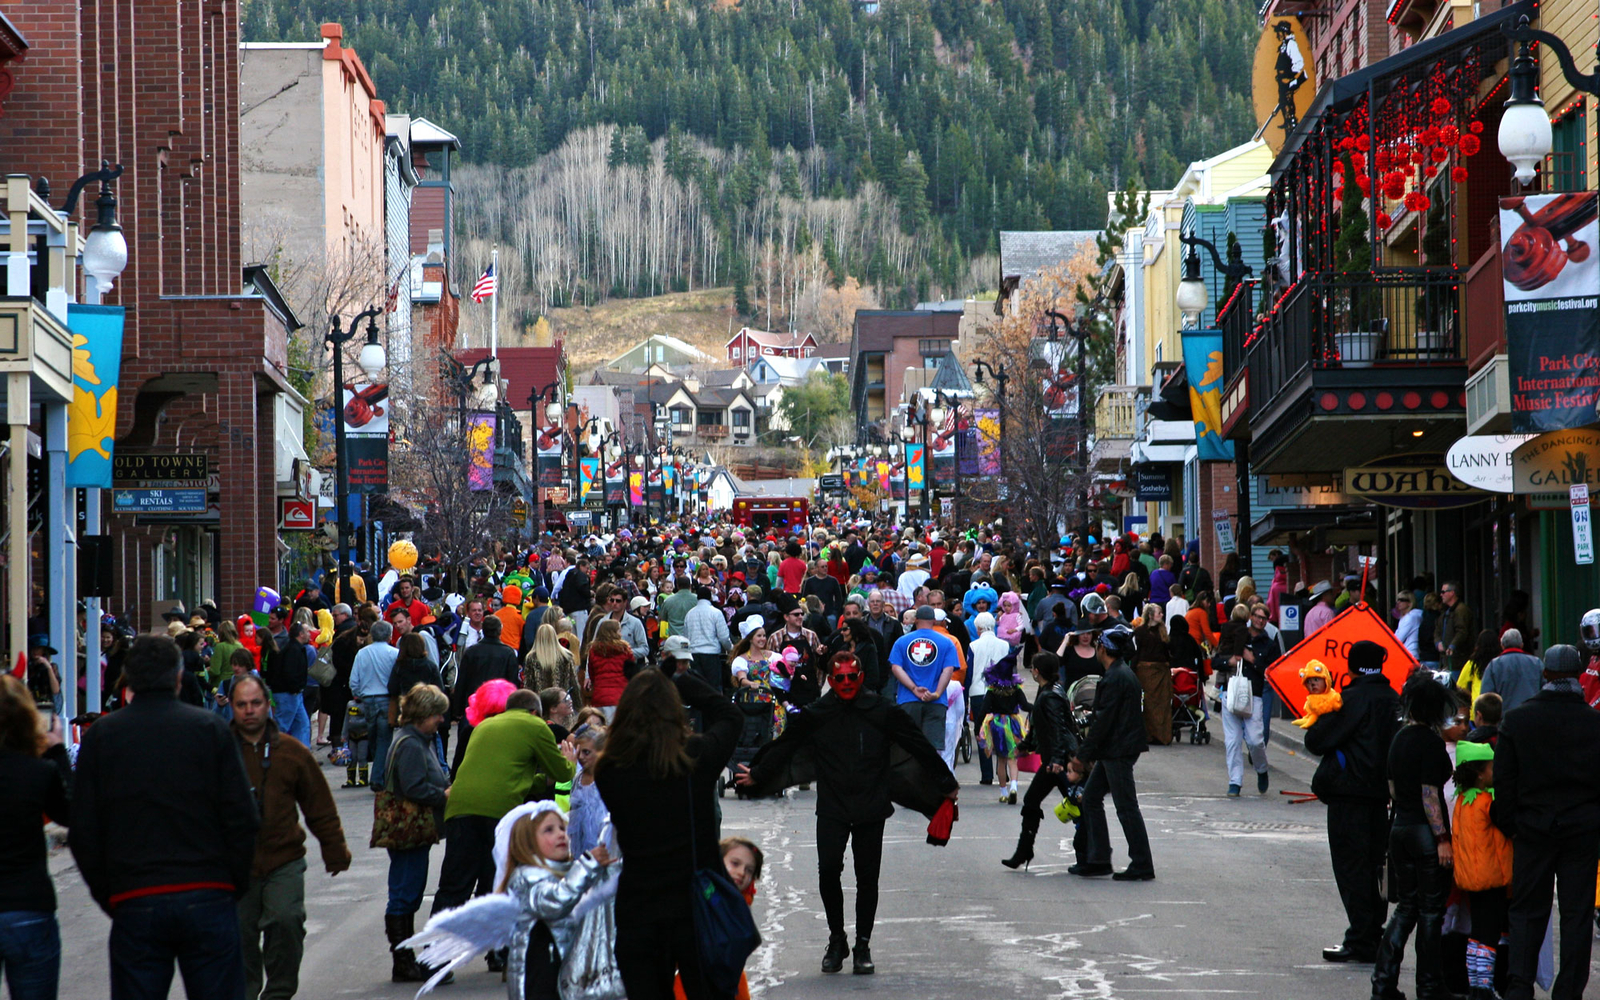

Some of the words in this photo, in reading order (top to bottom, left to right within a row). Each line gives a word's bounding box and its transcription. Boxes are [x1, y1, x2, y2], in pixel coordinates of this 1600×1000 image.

[1508, 298, 1598, 314] parkcitymusicfestival.org
[1539, 354, 1571, 371] Park
[1513, 392, 1552, 411] Music
[1541, 436, 1593, 451] DANCING
[115, 456, 145, 467] OLD
[151, 456, 204, 467] TOWNE
[1452, 452, 1500, 468] LANNY
[115, 469, 204, 478] GALLERY
[149, 490, 163, 498] SKI
[1140, 484, 1170, 493] Sotheby's
[1577, 543, 1589, 551] PARK
